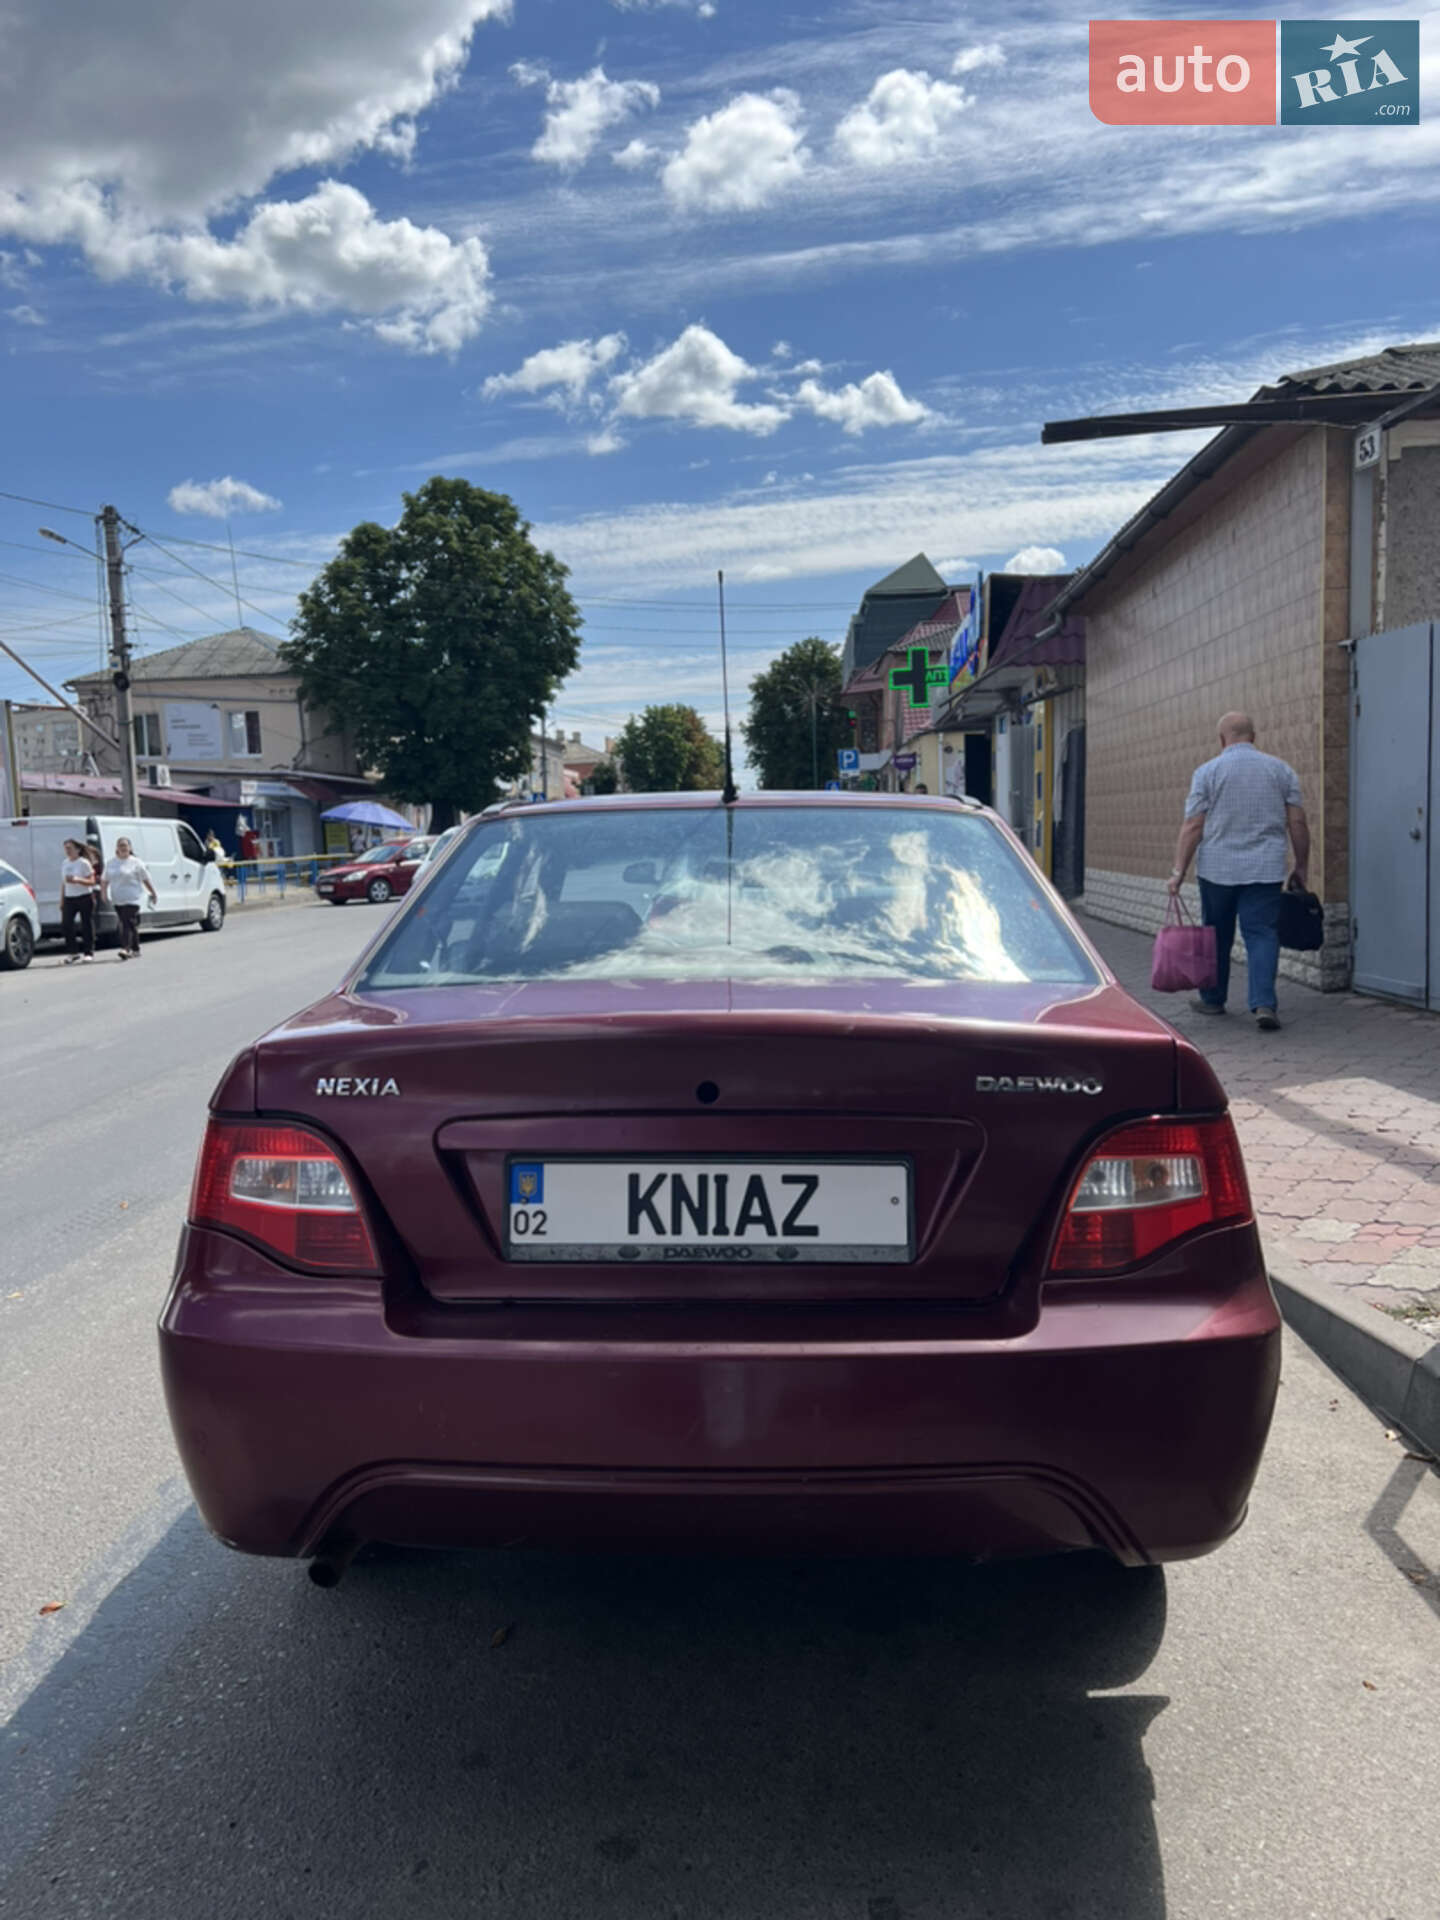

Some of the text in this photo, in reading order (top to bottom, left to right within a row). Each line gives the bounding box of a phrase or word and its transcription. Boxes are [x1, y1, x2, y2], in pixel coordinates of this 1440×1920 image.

[1360, 435, 1375, 461] 53
[842, 751, 856, 769] P
[316, 1077, 401, 1096] NEXIA
[975, 1075, 1104, 1095] DAEWOO
[627, 1172, 821, 1237] KNIAZ
[512, 1210, 548, 1236] 02
[663, 1246, 753, 1260] DAEWOO
